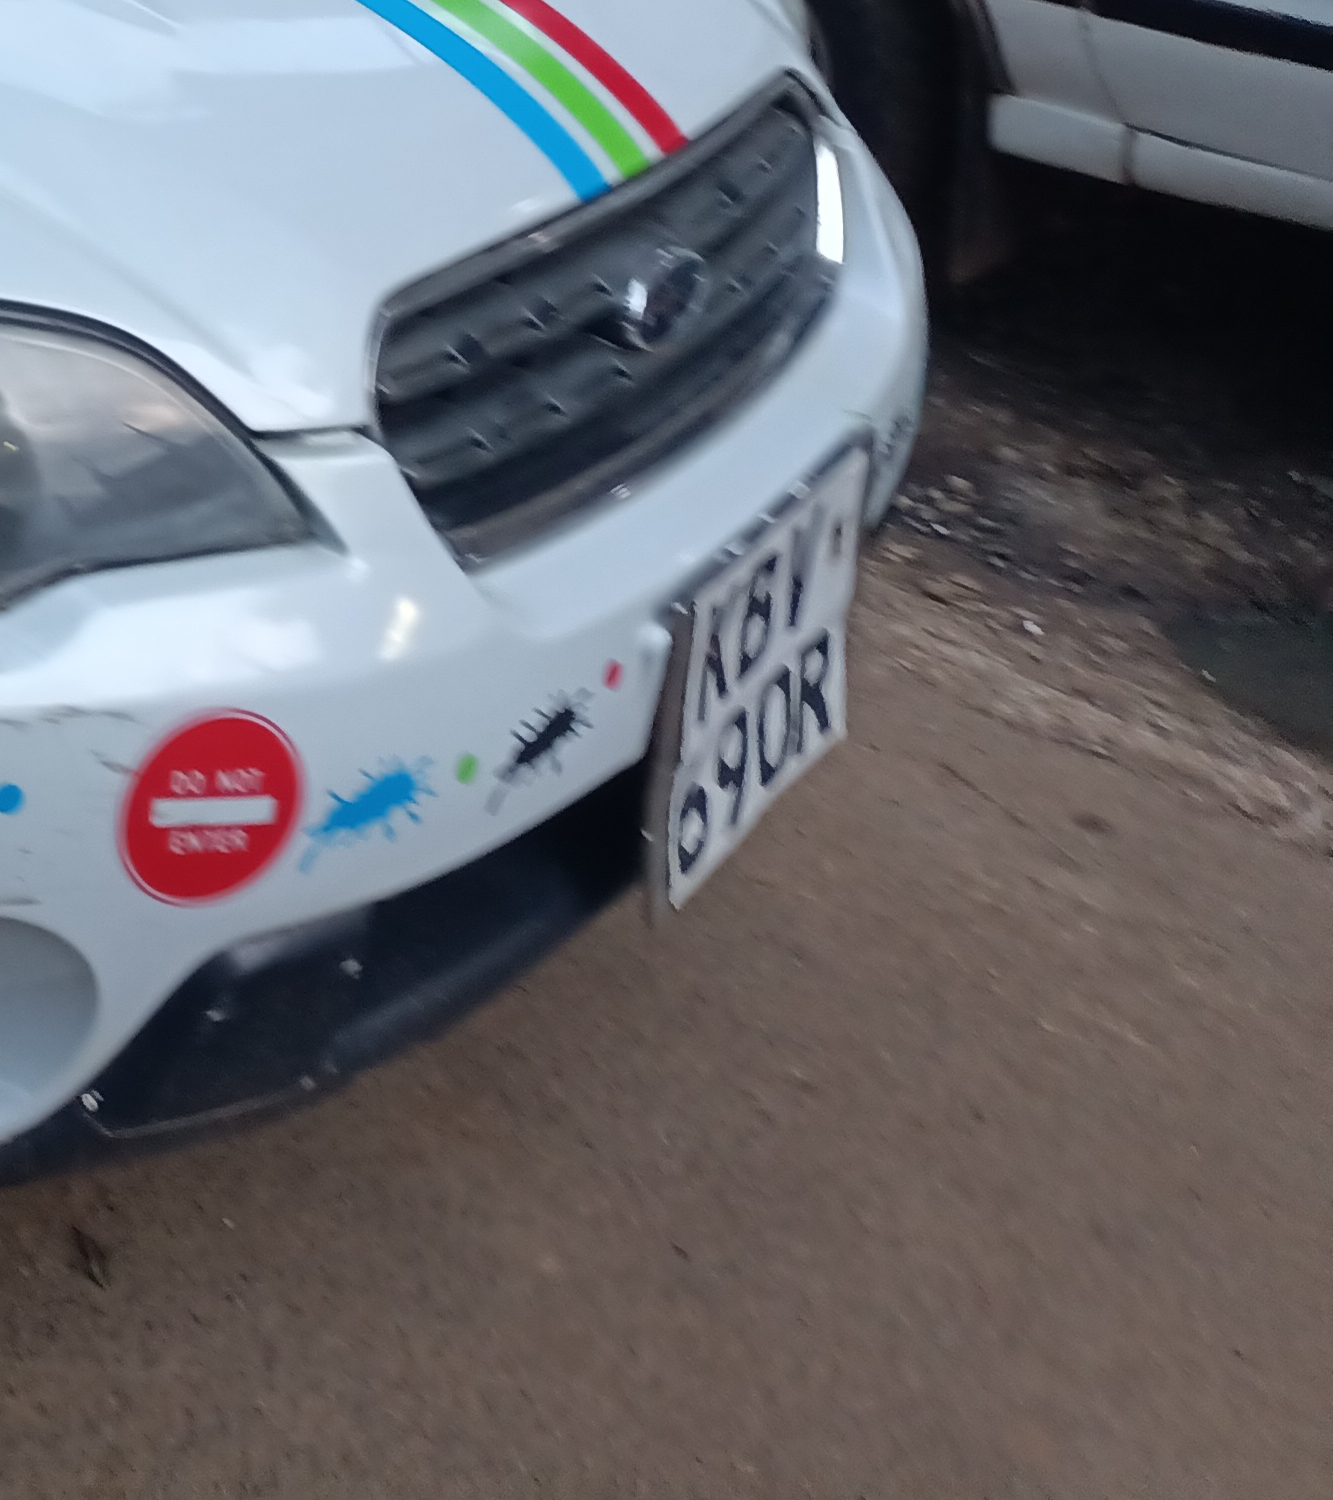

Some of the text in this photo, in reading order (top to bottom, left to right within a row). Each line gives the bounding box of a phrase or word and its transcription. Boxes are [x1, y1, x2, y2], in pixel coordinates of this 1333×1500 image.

[676, 626, 832, 876] 690R
[169, 766, 266, 796] DO NOT
[167, 827, 250, 856] ENTER
